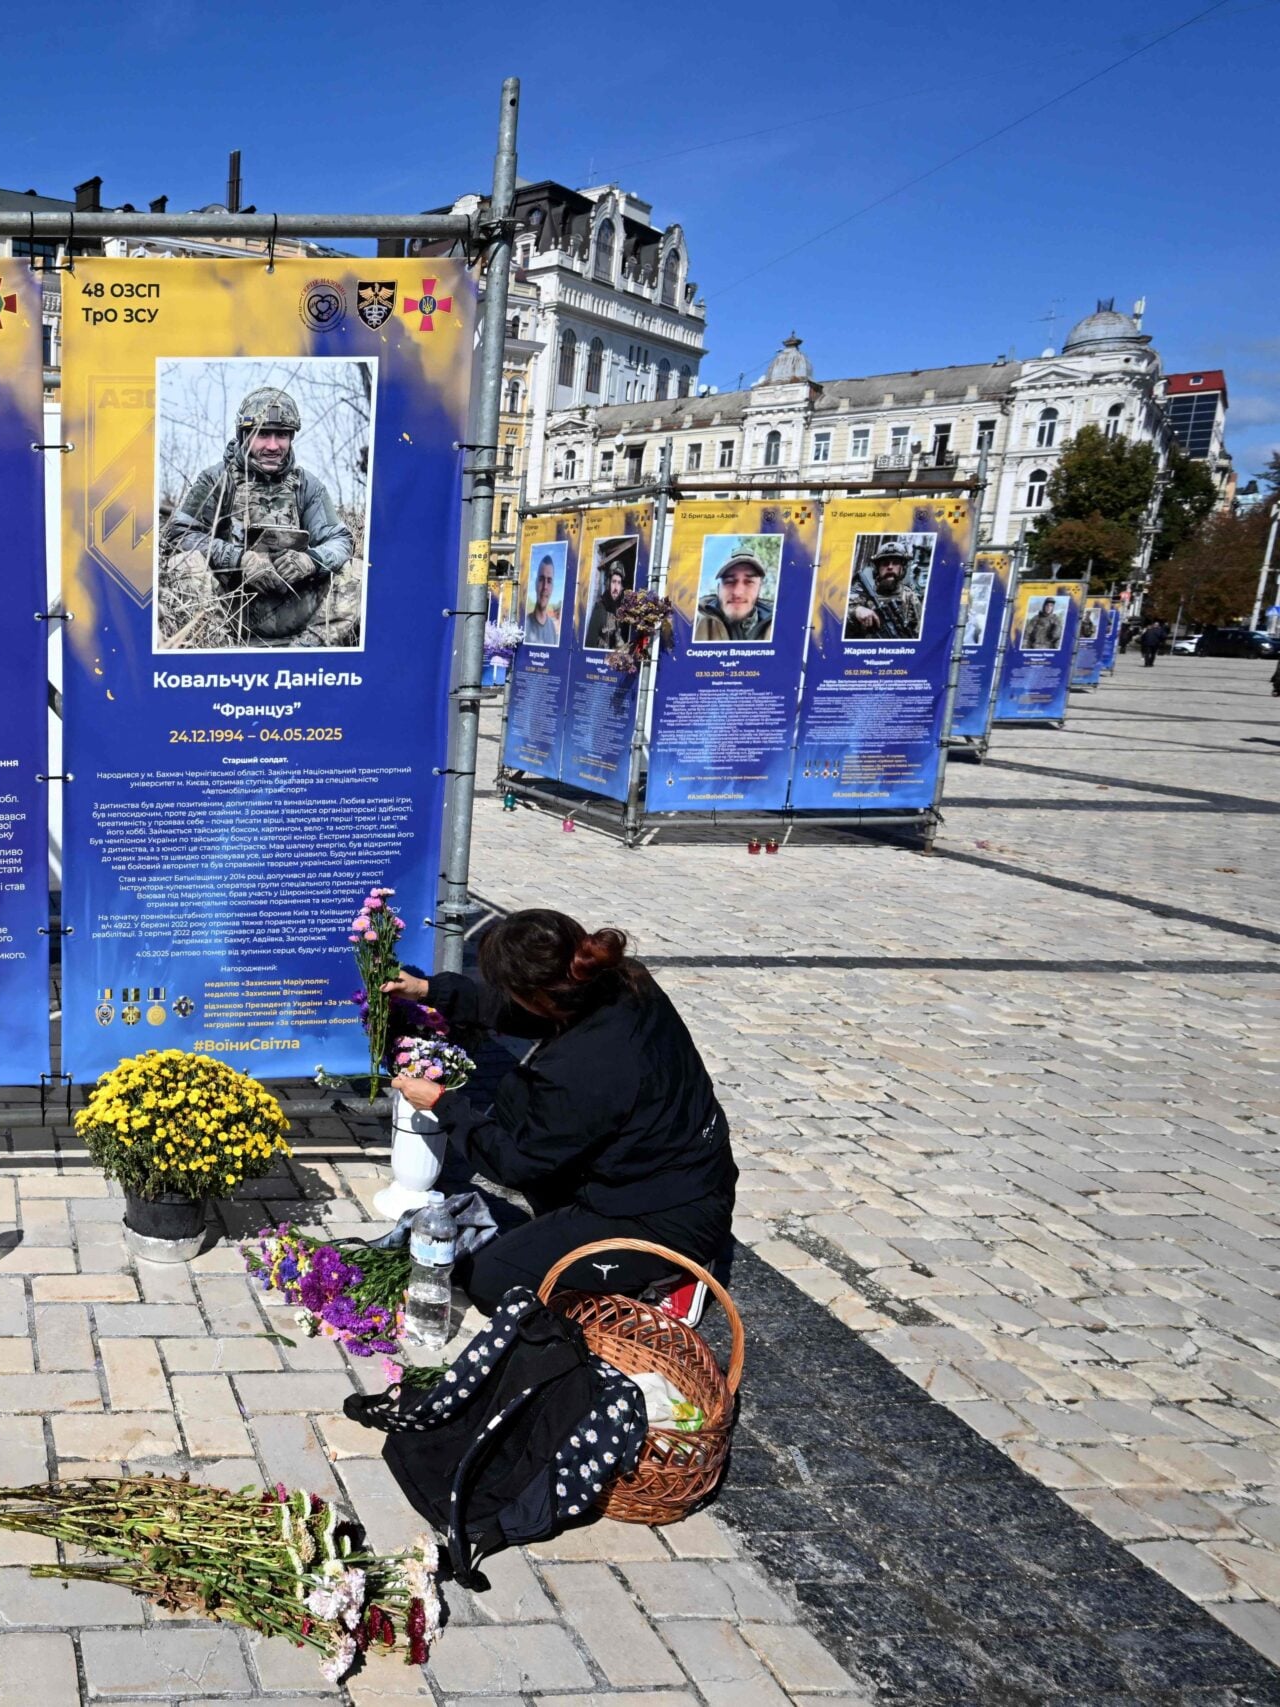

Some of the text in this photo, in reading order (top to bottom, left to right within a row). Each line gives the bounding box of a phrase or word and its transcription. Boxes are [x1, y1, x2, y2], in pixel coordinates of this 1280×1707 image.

[82, 283, 160, 298] 48 ОЗСП
[82, 308, 159, 326] ТрО ЗСУ
[686, 648, 775, 658] Сидорчук Владислав
[844, 646, 916, 657] Жарков Михайло
[153, 669, 362, 692] Ковальчук Даніель
[169, 729, 244, 743] 24.12.1994
[259, 728, 343, 741] 04.05.2025
[222, 756, 258, 765] Старший
[194, 1037, 300, 1051] #ВоїниСвітла
